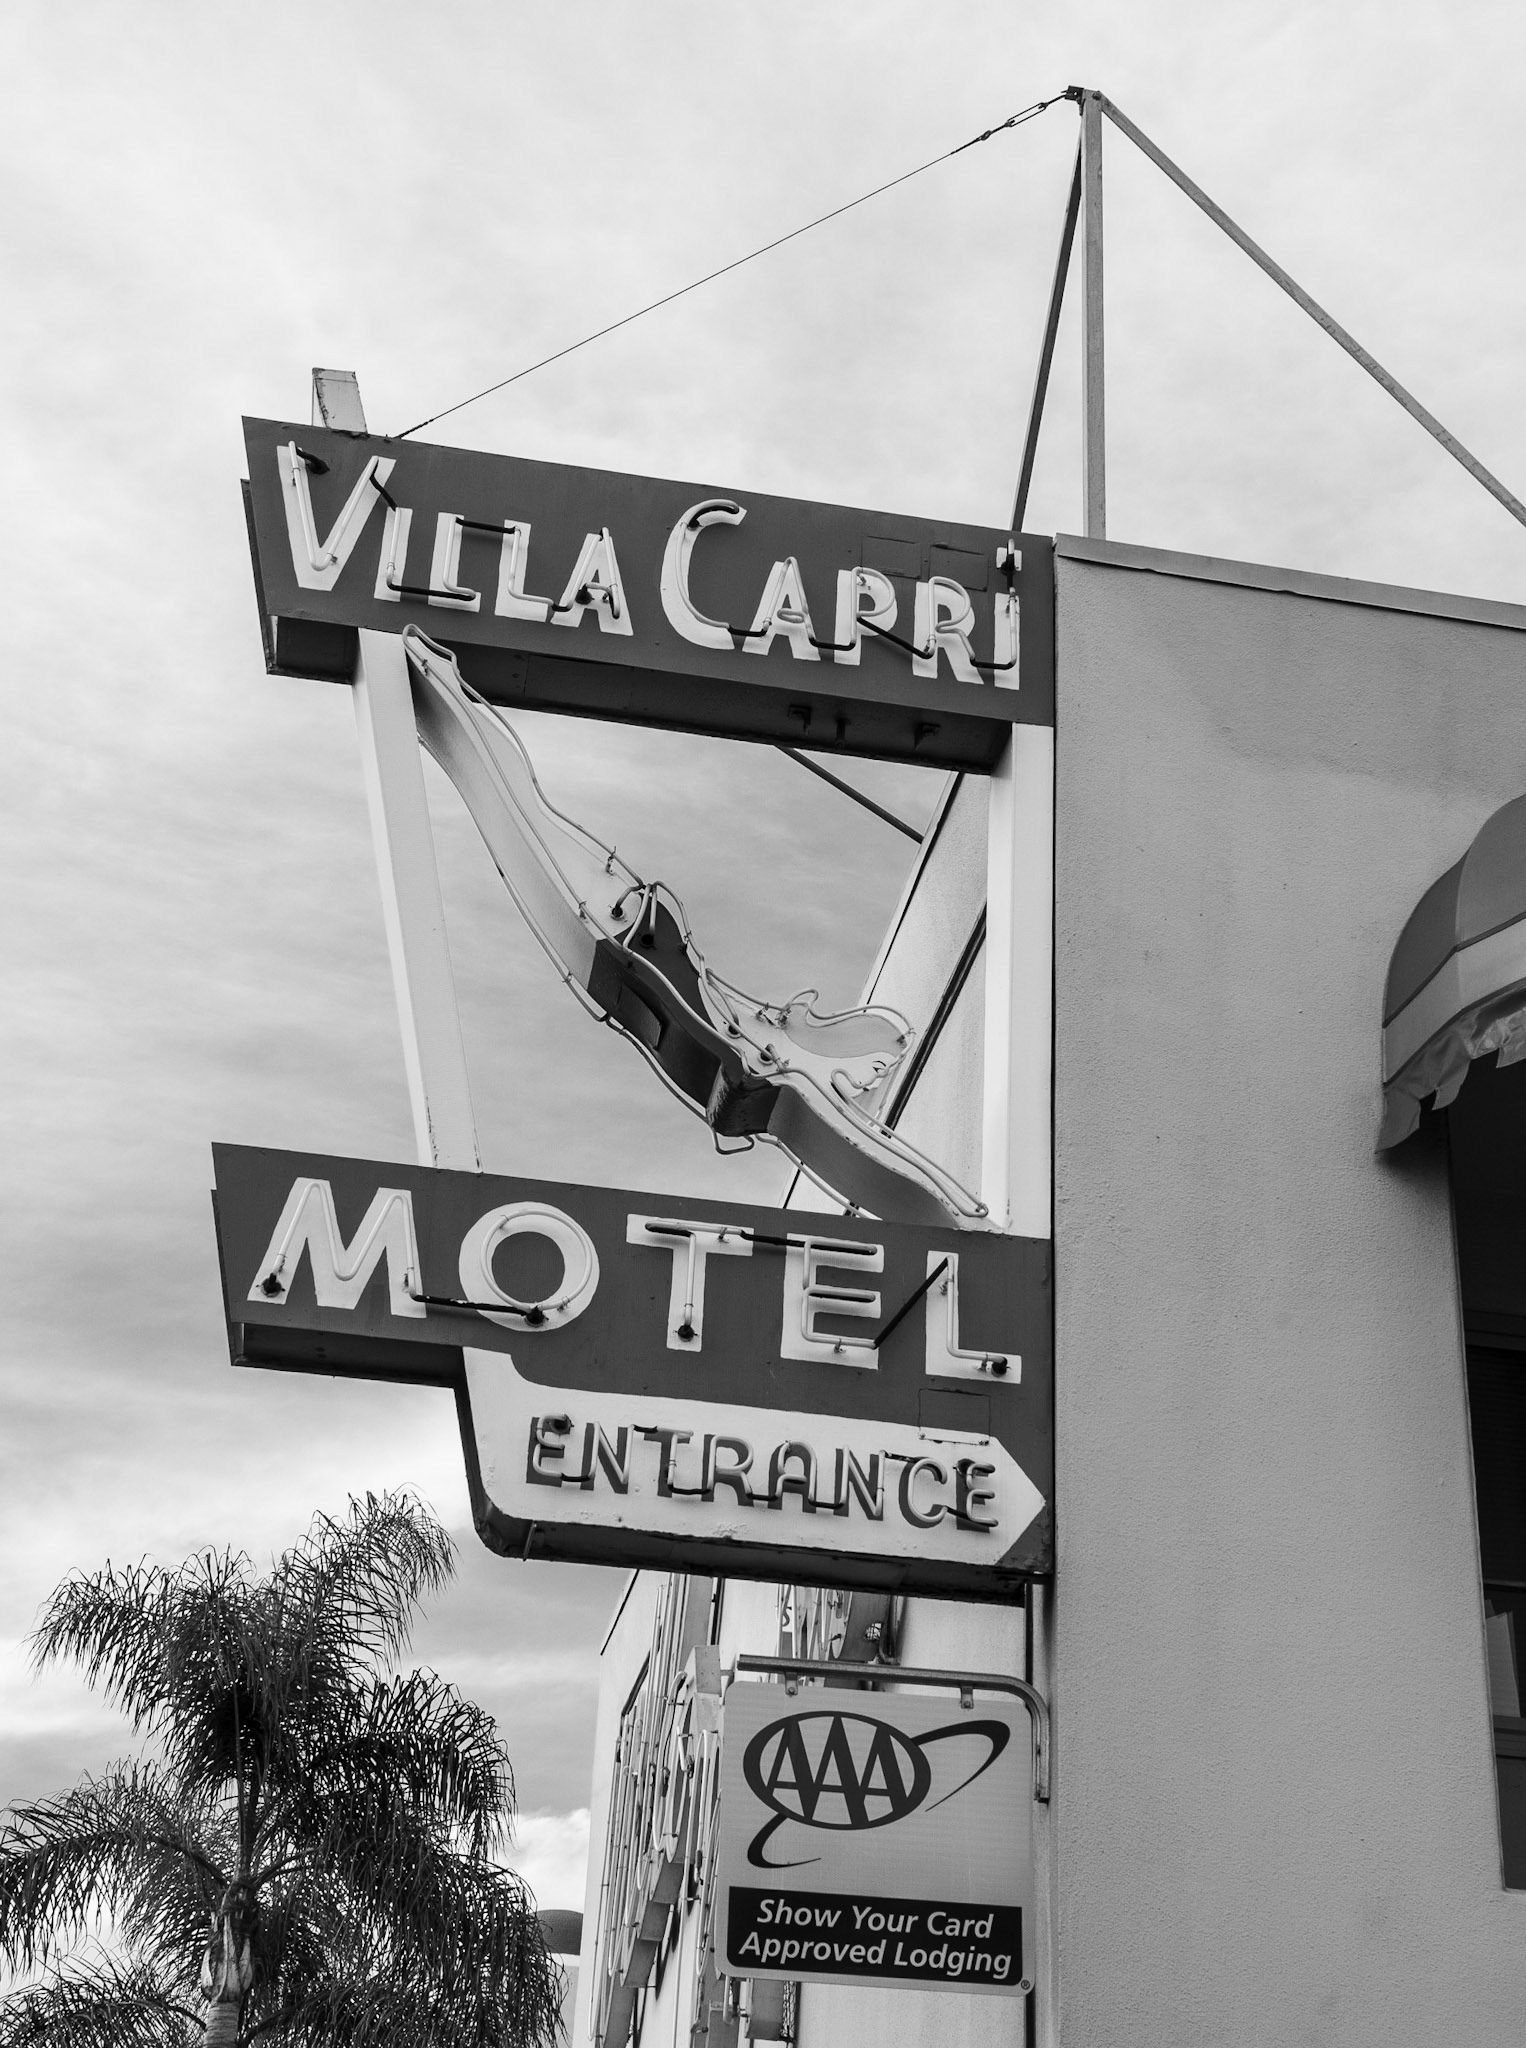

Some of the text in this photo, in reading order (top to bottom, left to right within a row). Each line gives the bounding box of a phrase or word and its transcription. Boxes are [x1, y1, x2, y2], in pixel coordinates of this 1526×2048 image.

[276, 440, 633, 636] VILLA
[246, 1177, 1022, 1384] MOTEL
[526, 1413, 999, 1529] ENTRANCE
[760, 1711, 912, 1830] AAA
[739, 1931, 1012, 1980] Approved Lodging
[757, 1899, 994, 1939] Show Your Card
